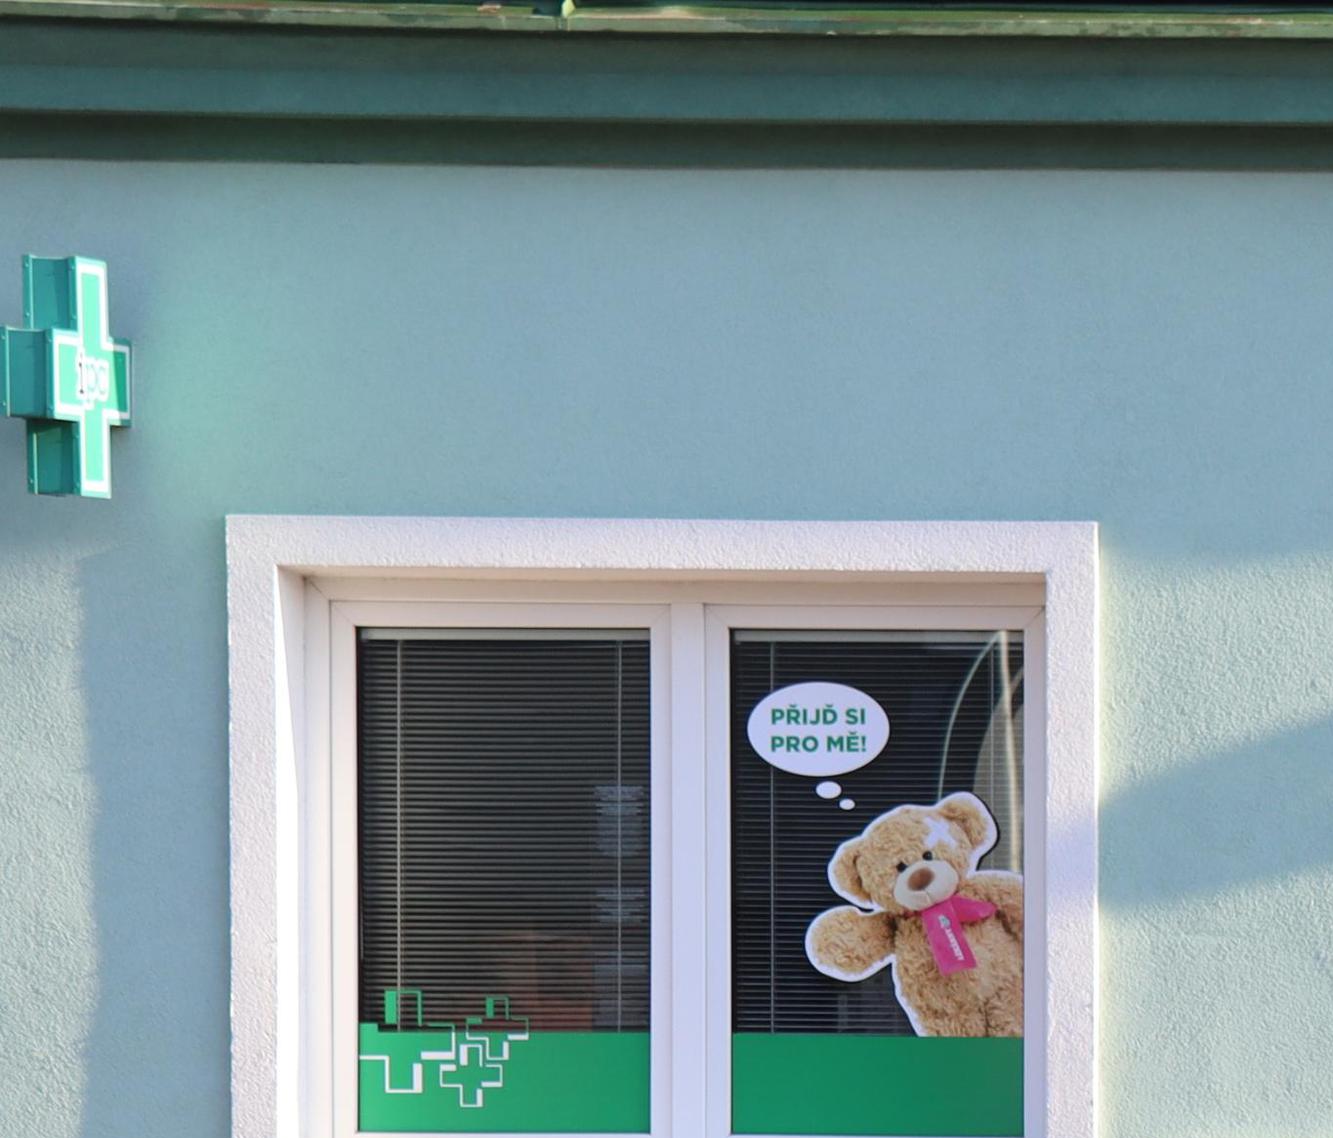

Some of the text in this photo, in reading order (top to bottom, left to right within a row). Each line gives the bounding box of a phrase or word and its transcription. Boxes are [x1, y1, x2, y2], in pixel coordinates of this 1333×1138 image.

[771, 704, 866, 726] PŘIJĎ SI
[771, 731, 867, 752] PRO MĚ!
